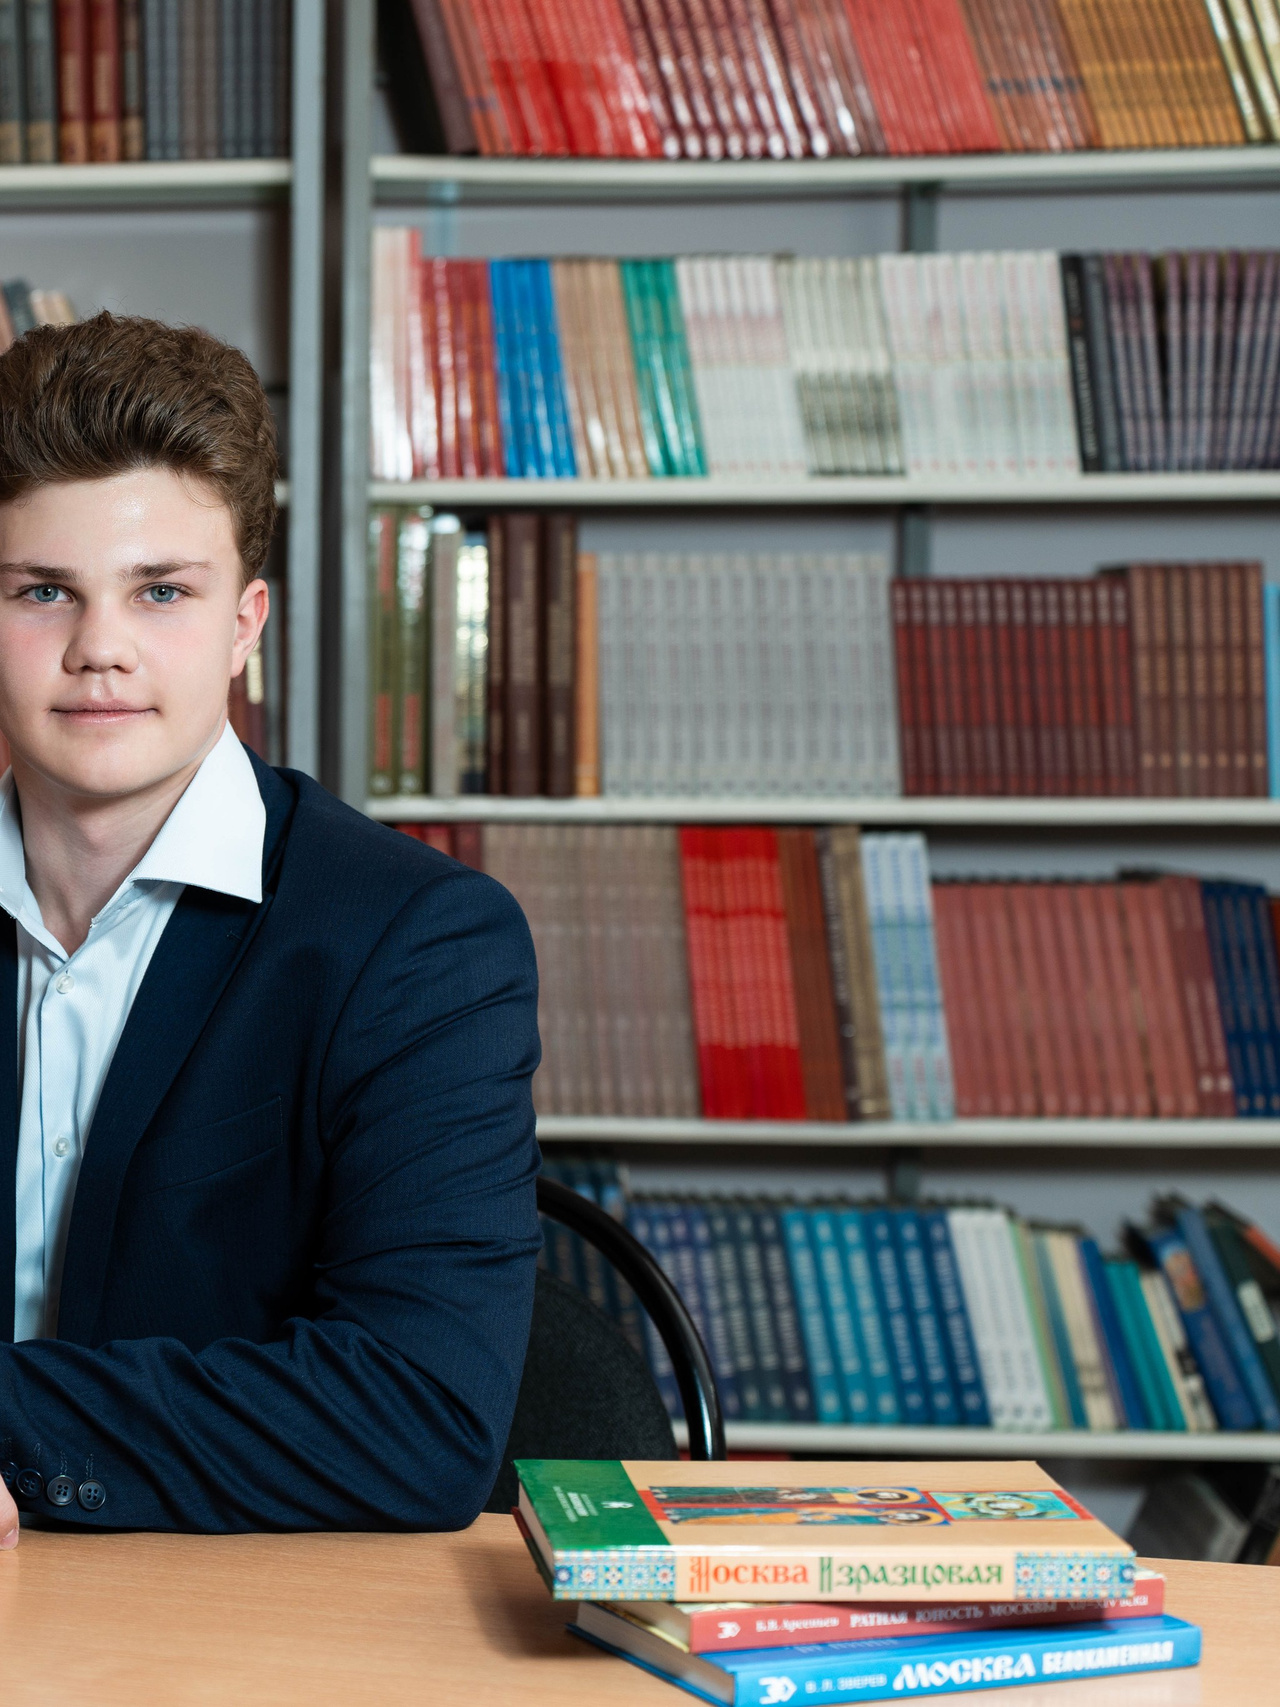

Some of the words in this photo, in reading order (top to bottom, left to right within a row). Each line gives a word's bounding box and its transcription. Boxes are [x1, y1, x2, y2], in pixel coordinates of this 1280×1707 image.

[689, 1556, 809, 1593] Москва
[819, 1556, 1004, 1593] Изразцовая
[850, 1610, 908, 1628] РАТНАЯ
[915, 1606, 983, 1623] ЮНОСТЬ
[892, 1653, 1037, 1691] МОСКВА
[1042, 1640, 1175, 1675] БЕЛОКАМЕННАЯ
